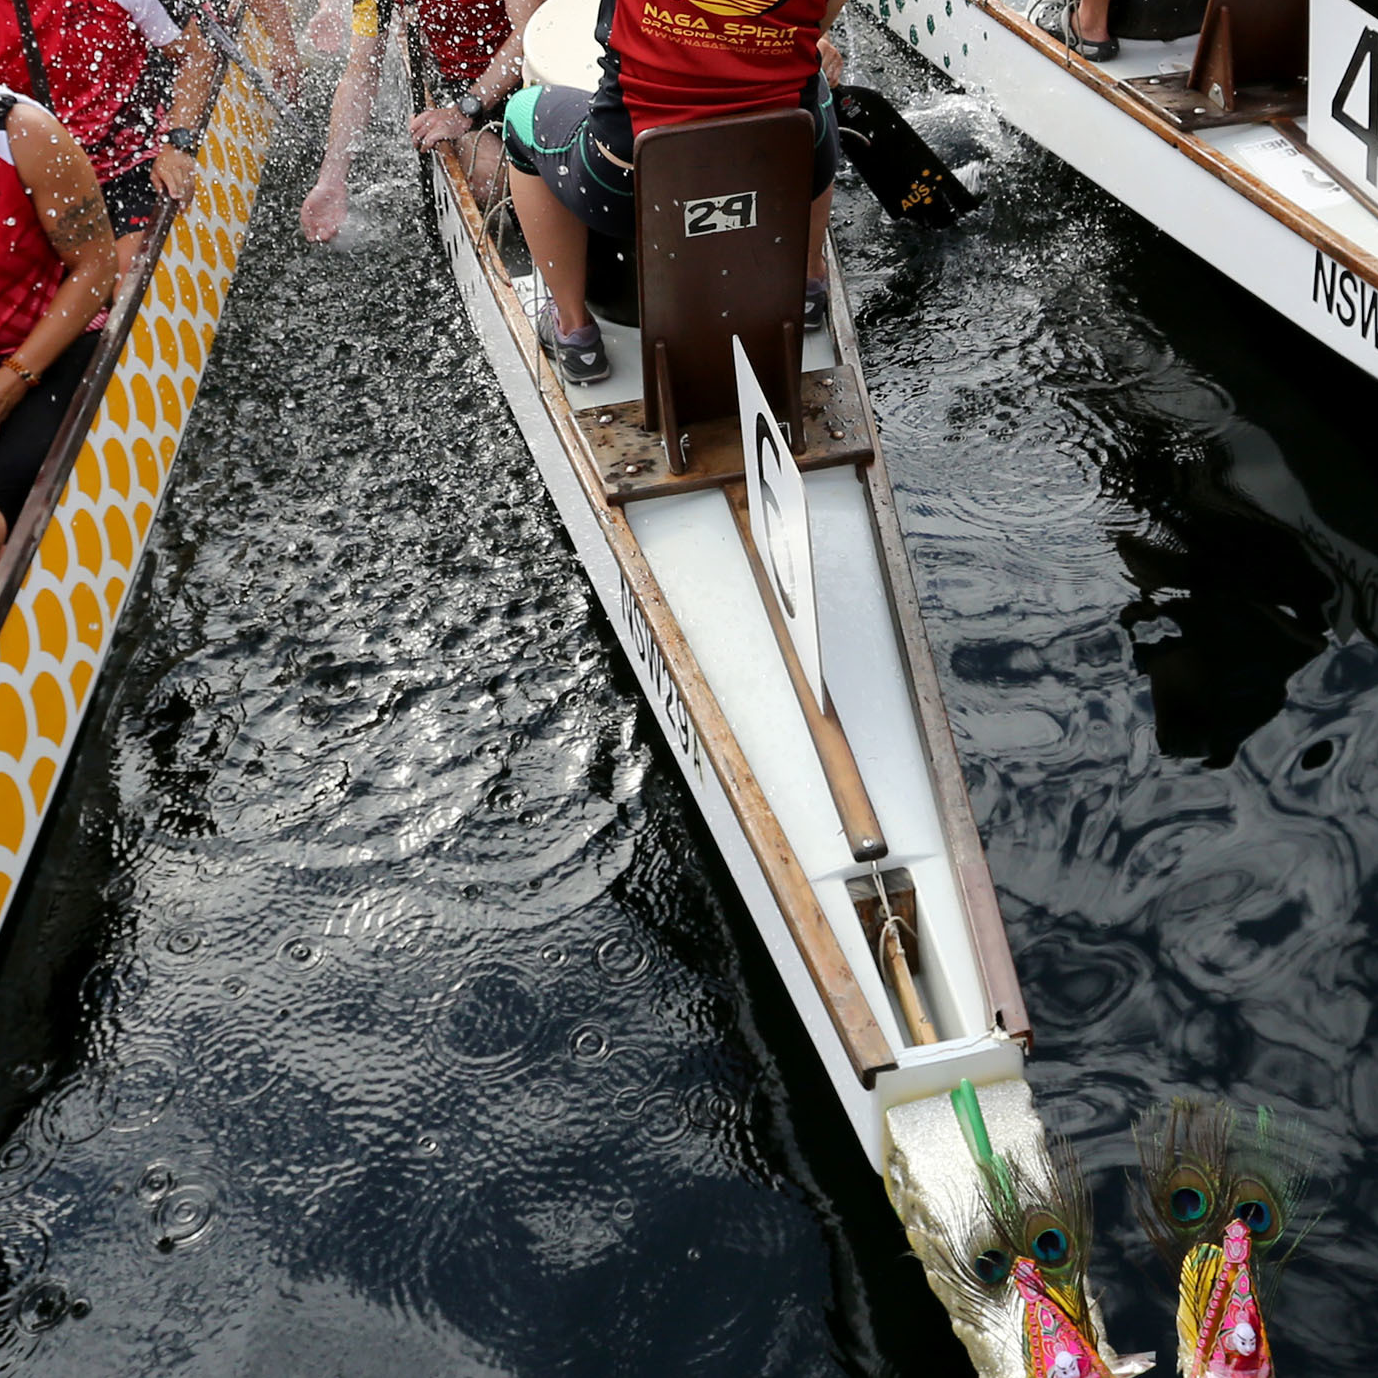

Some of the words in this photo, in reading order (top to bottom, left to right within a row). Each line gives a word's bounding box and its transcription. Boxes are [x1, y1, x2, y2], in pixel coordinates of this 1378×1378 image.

[641, 16, 747, 46] DRAGONBOAT
[754, 39, 795, 48] TEAM
[643, 2, 710, 31] NAGA
[723, 22, 799, 40] SPIRIT
[687, 193, 754, 235] 29
[900, 184, 931, 212] AUS
